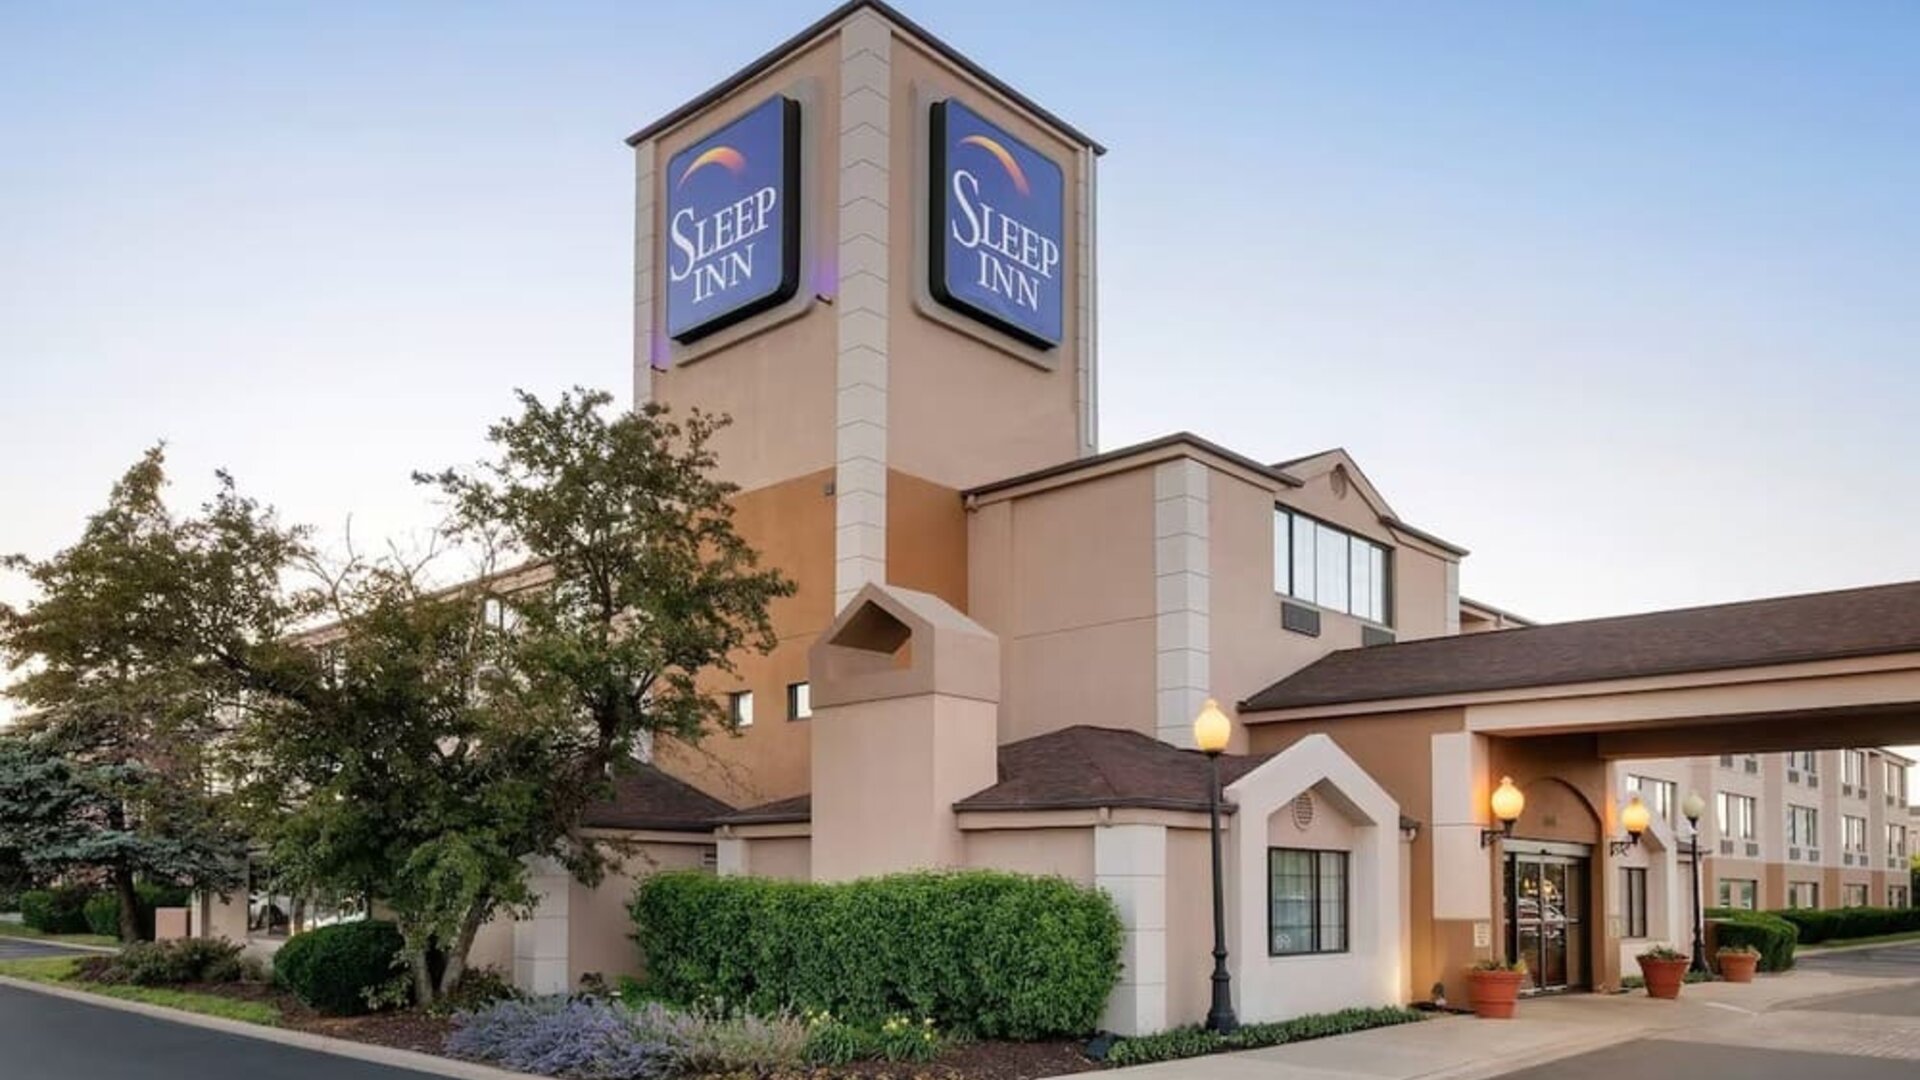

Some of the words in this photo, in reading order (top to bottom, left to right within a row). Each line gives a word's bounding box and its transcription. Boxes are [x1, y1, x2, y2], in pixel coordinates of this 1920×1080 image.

[670, 186, 776, 281] SLEEP
[952, 169, 1059, 278] SLEEP
[692, 243, 755, 304] INN
[977, 250, 1039, 311] INN
